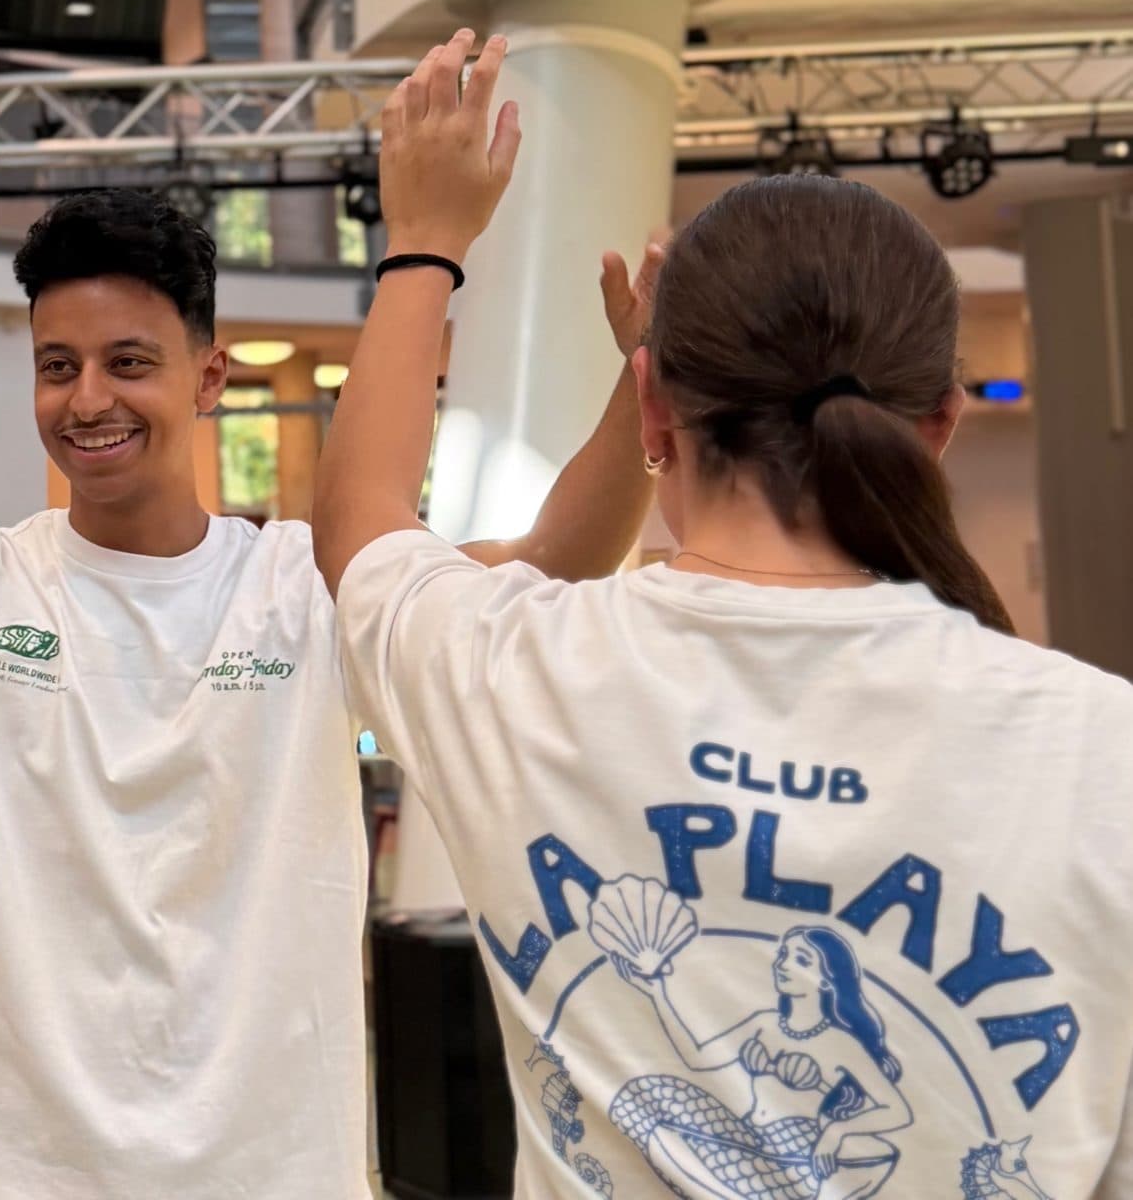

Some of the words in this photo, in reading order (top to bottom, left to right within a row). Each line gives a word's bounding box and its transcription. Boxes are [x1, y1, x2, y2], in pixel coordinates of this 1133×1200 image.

[8, 663, 57, 684] WORLDWIDE
[221, 650, 254, 659] OPEN
[689, 741, 868, 804] CLUB
[478, 832, 606, 995] LA
[645, 803, 1081, 1112] PLAYA
